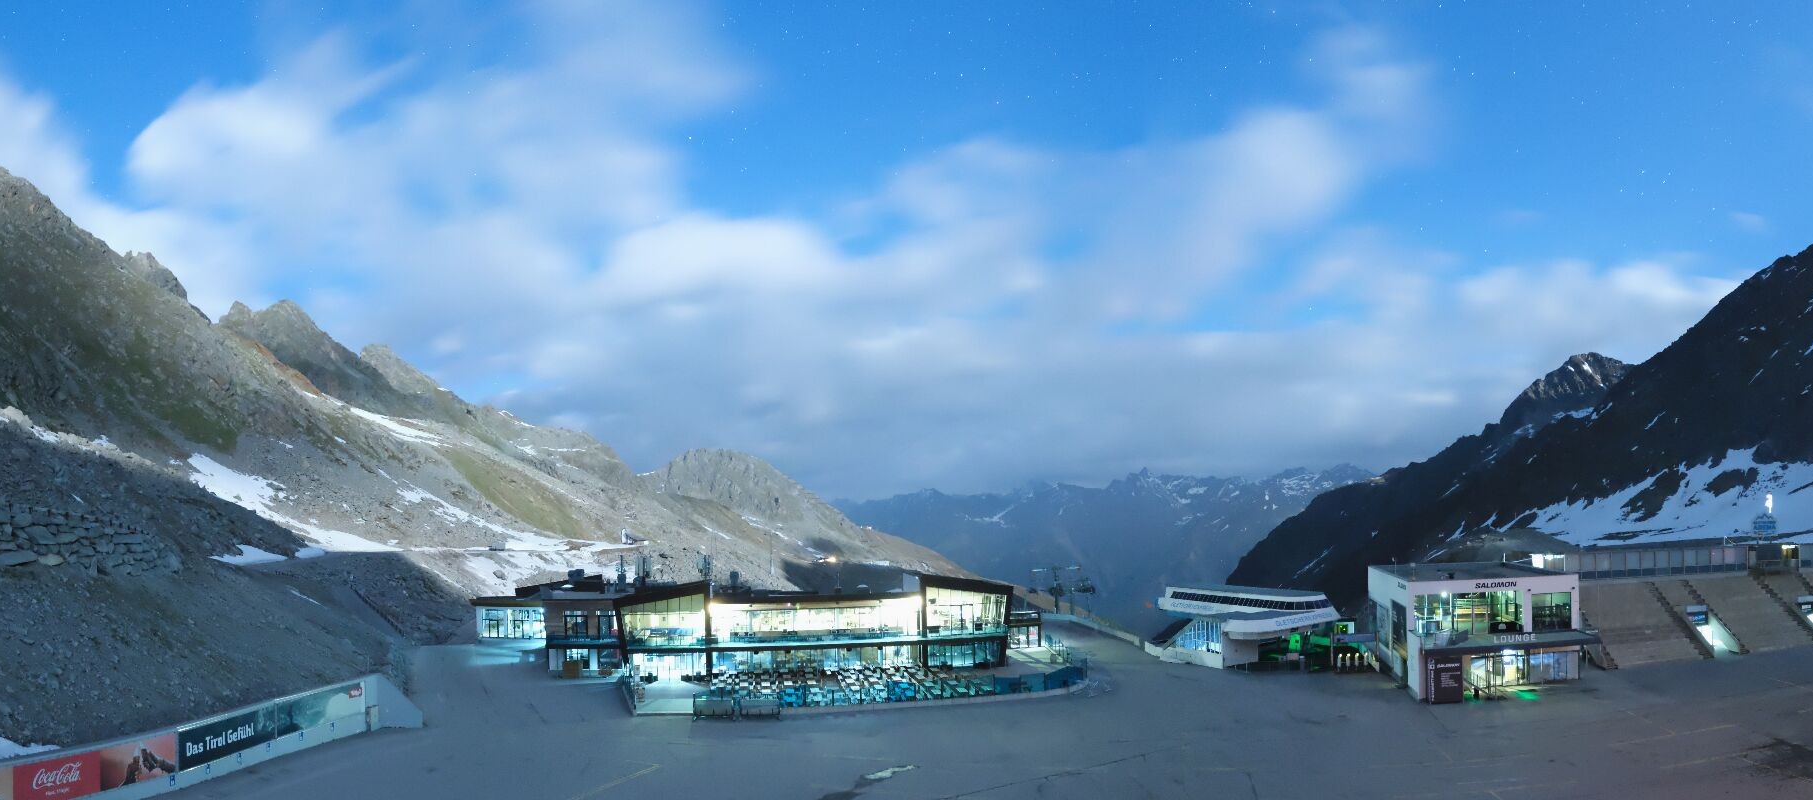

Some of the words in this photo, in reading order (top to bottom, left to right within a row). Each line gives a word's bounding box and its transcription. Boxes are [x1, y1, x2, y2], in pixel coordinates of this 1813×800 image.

[1475, 581, 1517, 589] SALOMON
[1493, 633, 1537, 644] LOUNGE
[186, 742, 204, 757] Das
[205, 731, 226, 751] Tirol
[227, 722, 255, 744] Gefühl
